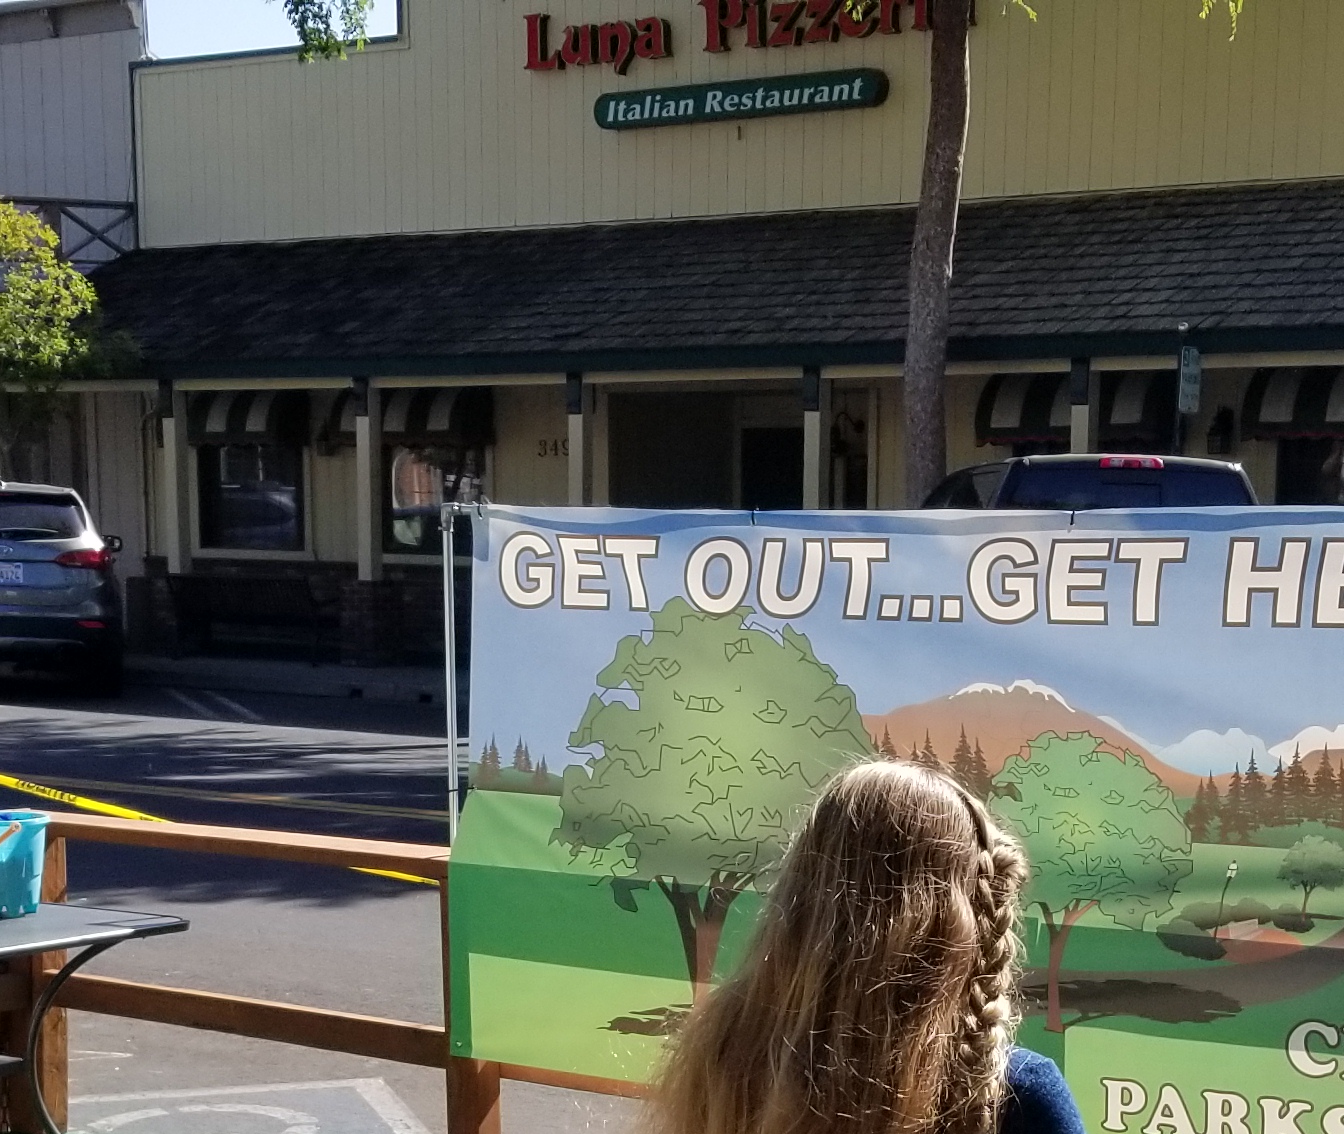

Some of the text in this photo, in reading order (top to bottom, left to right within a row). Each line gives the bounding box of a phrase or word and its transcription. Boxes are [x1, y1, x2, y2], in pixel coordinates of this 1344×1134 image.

[523, 0, 976, 77] Luna Pizzeri
[606, 77, 863, 124] Italian Restaurant
[498, 532, 660, 611] GET
